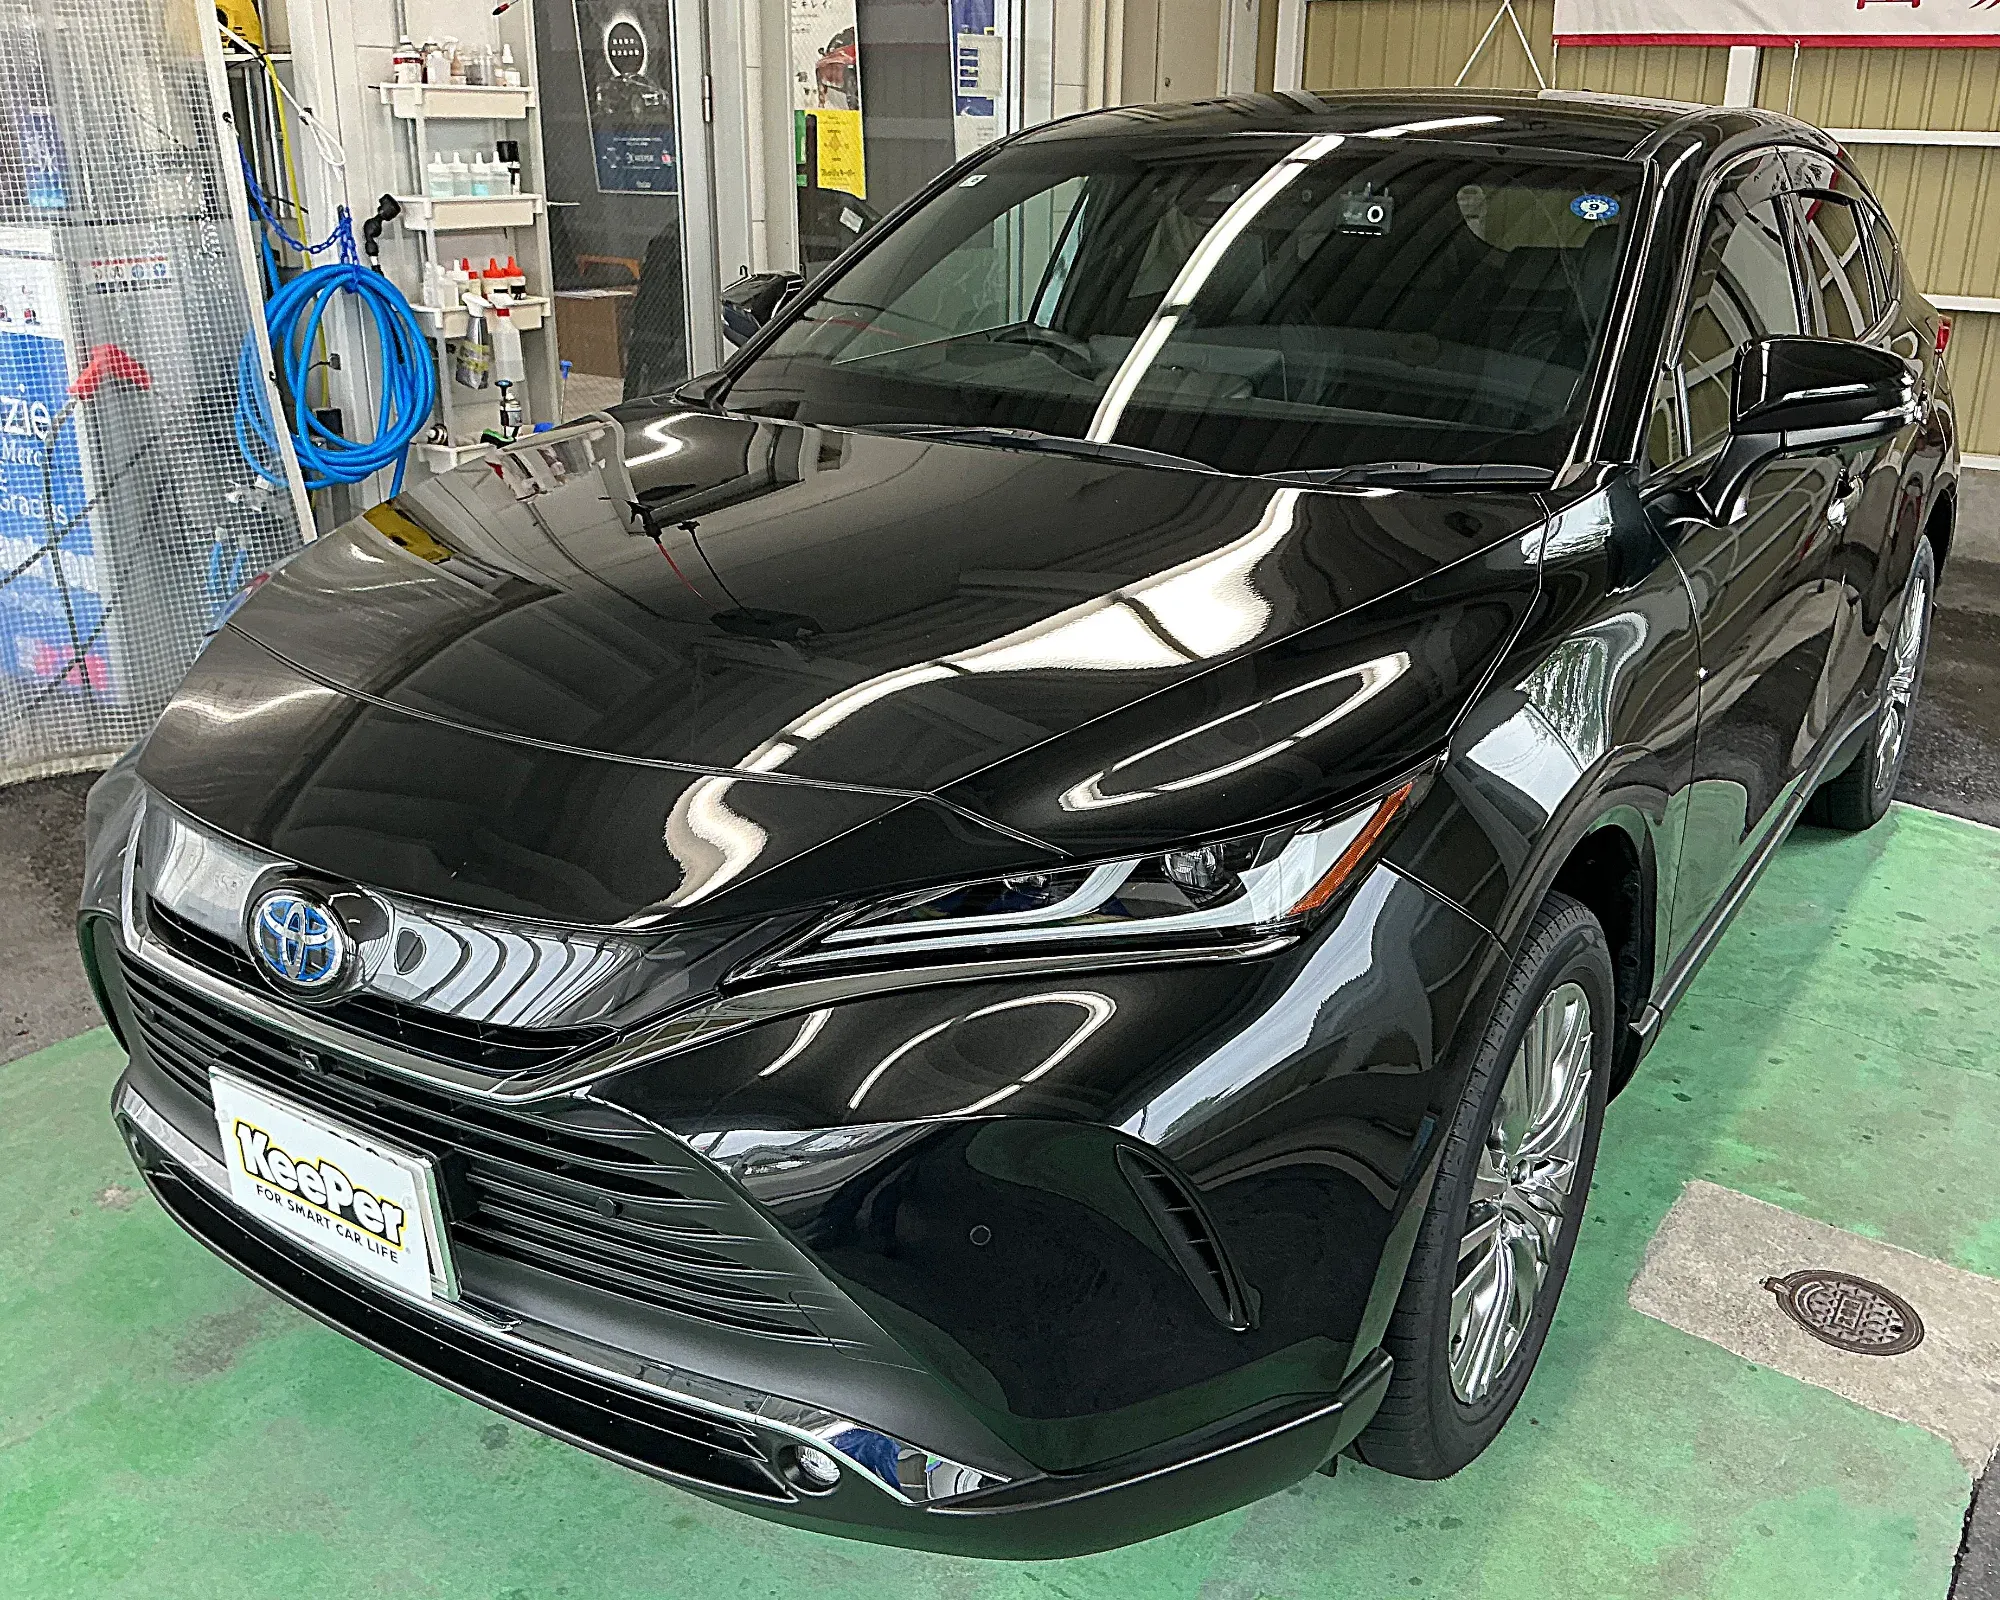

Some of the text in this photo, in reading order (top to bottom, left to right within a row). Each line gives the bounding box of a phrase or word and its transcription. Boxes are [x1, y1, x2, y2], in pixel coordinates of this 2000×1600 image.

[235, 1119, 407, 1251] KeePer
[256, 1184, 400, 1264] FOR SMART CAR LIFE
